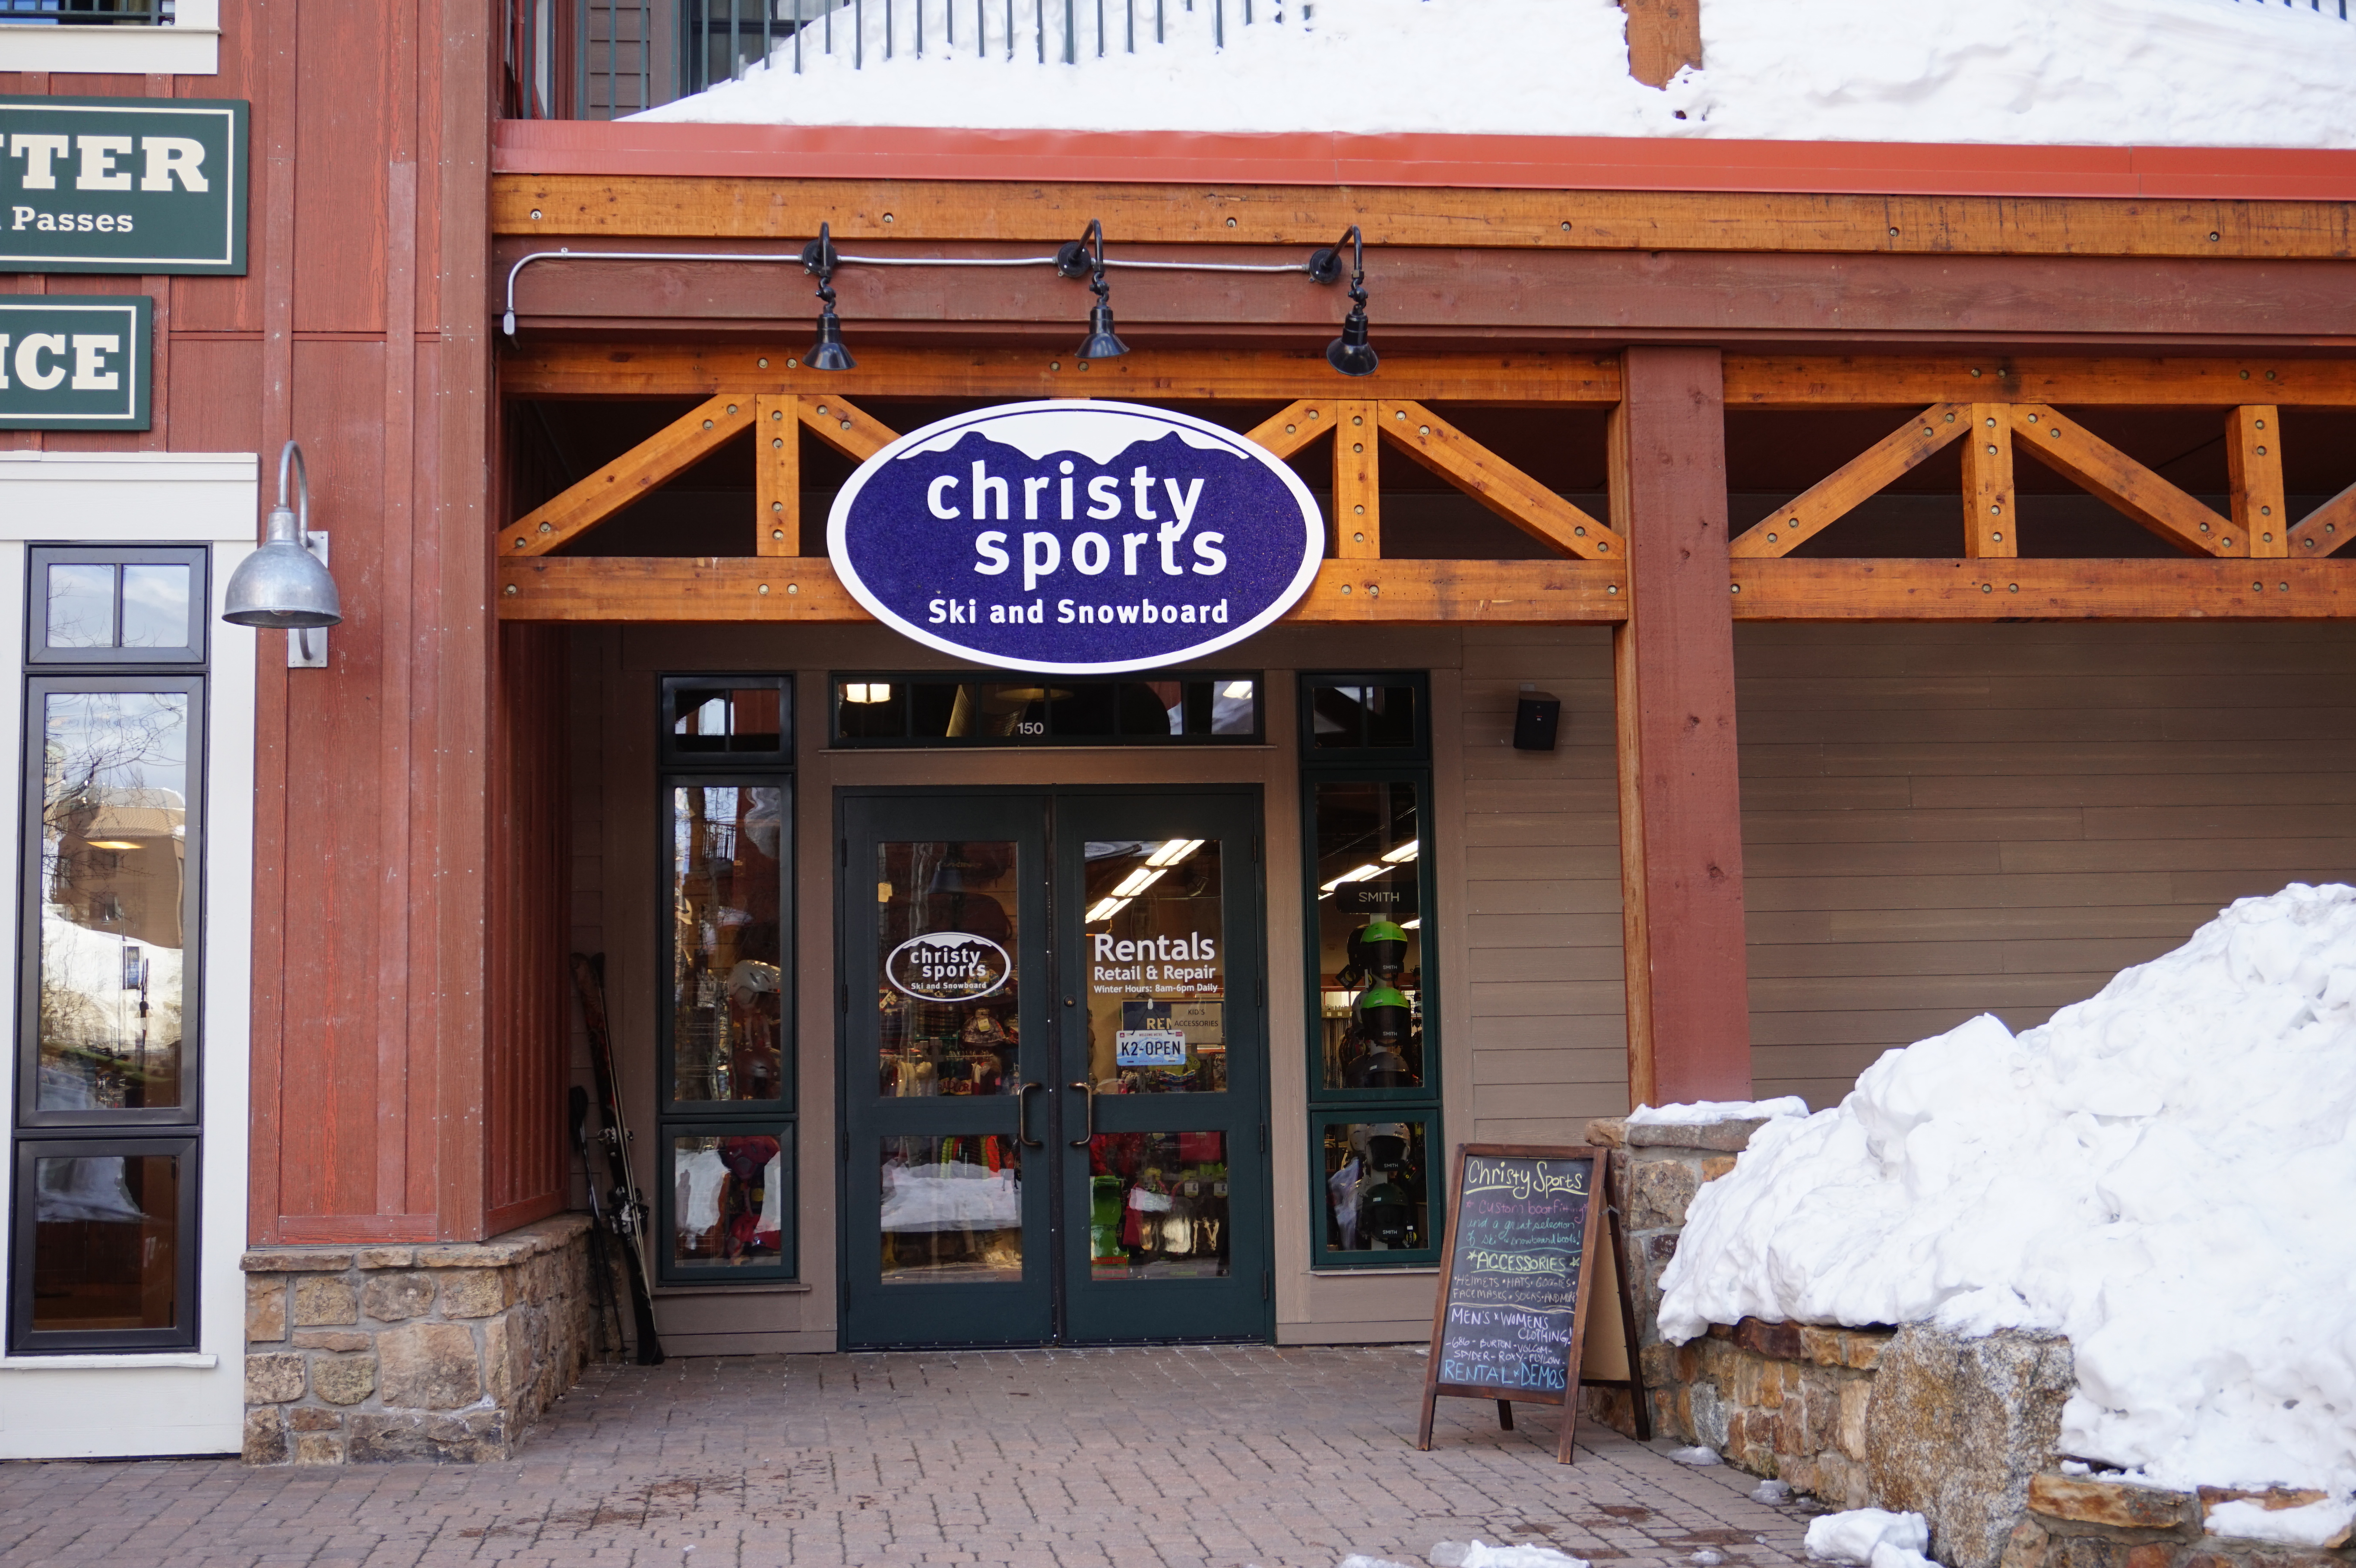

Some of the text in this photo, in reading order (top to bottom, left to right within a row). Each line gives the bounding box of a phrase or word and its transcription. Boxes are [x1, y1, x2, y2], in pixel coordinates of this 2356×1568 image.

[0, 134, 209, 192] TER
[12, 206, 133, 232] Passes
[927, 458, 1205, 536] christy
[974, 520, 1226, 591] sports
[928, 599, 1228, 624] Ski and Snowboard
[1017, 722, 1044, 734] 150
[1359, 892, 1400, 902] SMITH
[1095, 931, 1215, 962] Rentals
[910, 947, 980, 968] christy
[922, 962, 986, 981] sports
[1094, 964, 1216, 983] Retail & Repair
[1093, 983, 1218, 993] Winter Hours: 8am-6pm Daily
[1121, 1041, 1180, 1056] K2-OPEN
[1469, 1160, 1582, 1199] Christy Sports
[1479, 1199, 1523, 1214] Custom
[1466, 1217, 1488, 1228] and
[1492, 1220, 1498, 1229] a
[1532, 1217, 1575, 1231] selection
[1466, 1230, 1476, 1246] of
[1476, 1251, 1566, 1272] ACCESSORIES
[1451, 1308, 1490, 1325] MEN'S
[1501, 1311, 1548, 1330] WOMEN'S
[1480, 1338, 1511, 1349] BURTON
[1444, 1359, 1514, 1385] RENTAL
[1520, 1362, 1565, 1389] DEMOS
